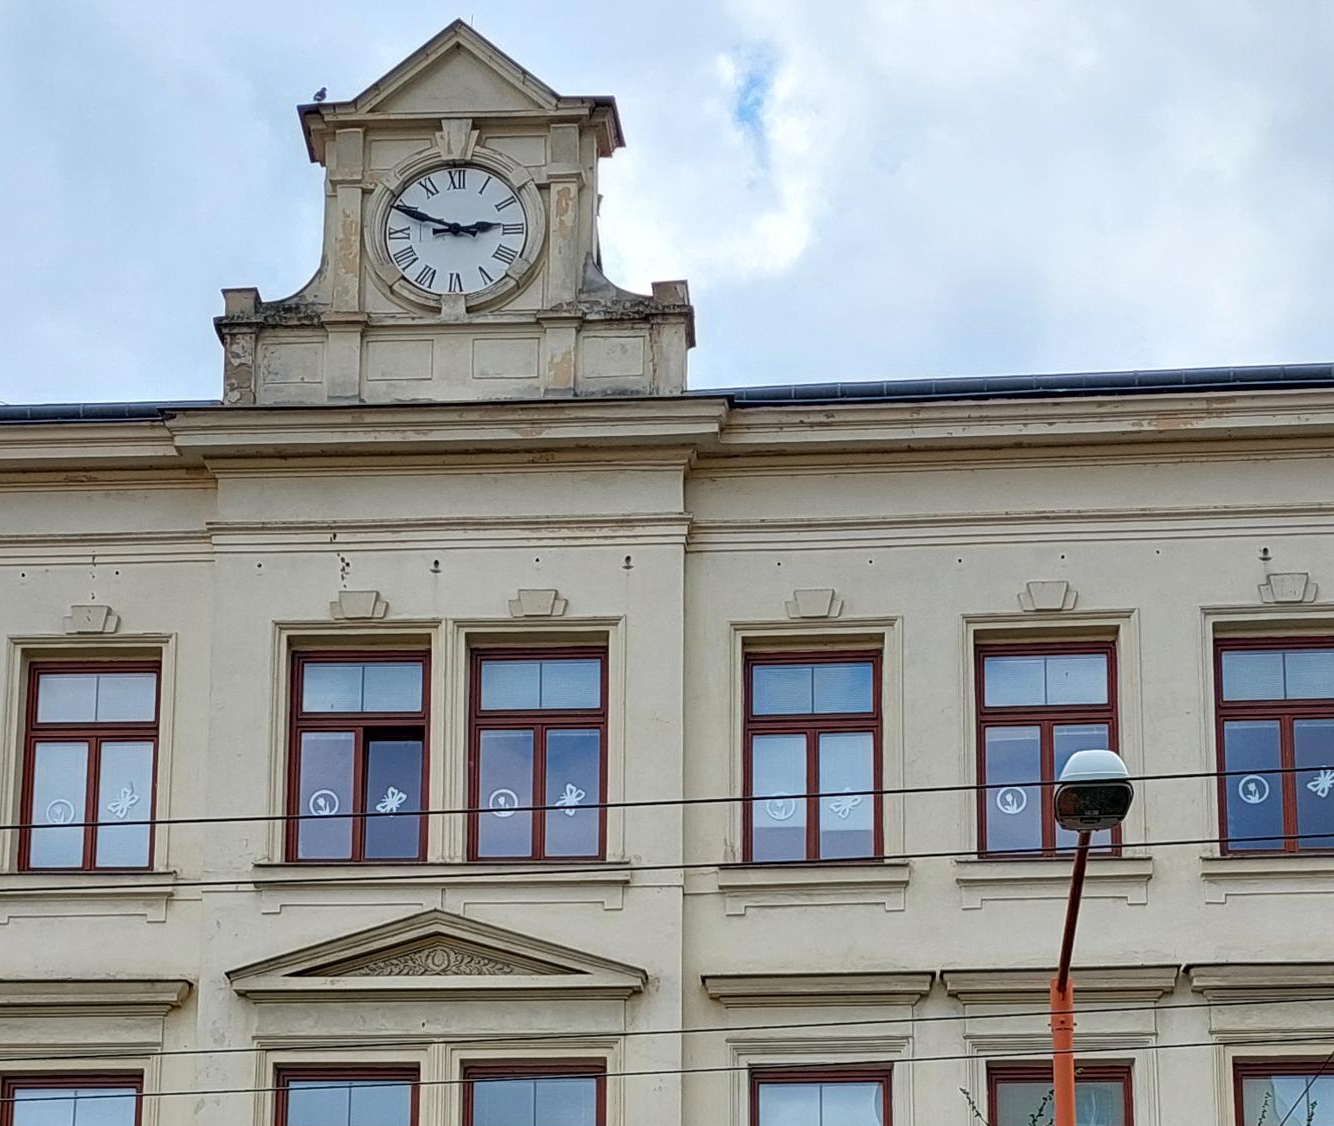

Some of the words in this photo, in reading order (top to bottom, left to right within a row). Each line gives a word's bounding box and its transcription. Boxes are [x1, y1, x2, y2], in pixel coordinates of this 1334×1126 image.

[418, 176, 440, 199] XI
[447, 170, 466, 189] XII
[478, 176, 492, 195] I
[494, 196, 517, 212] II
[389, 226, 410, 240] IX
[502, 223, 524, 235] III
[393, 245, 419, 272] VIII
[415, 265, 437, 289] VII
[449, 273, 463, 292] VI
[478, 266, 494, 285] V
